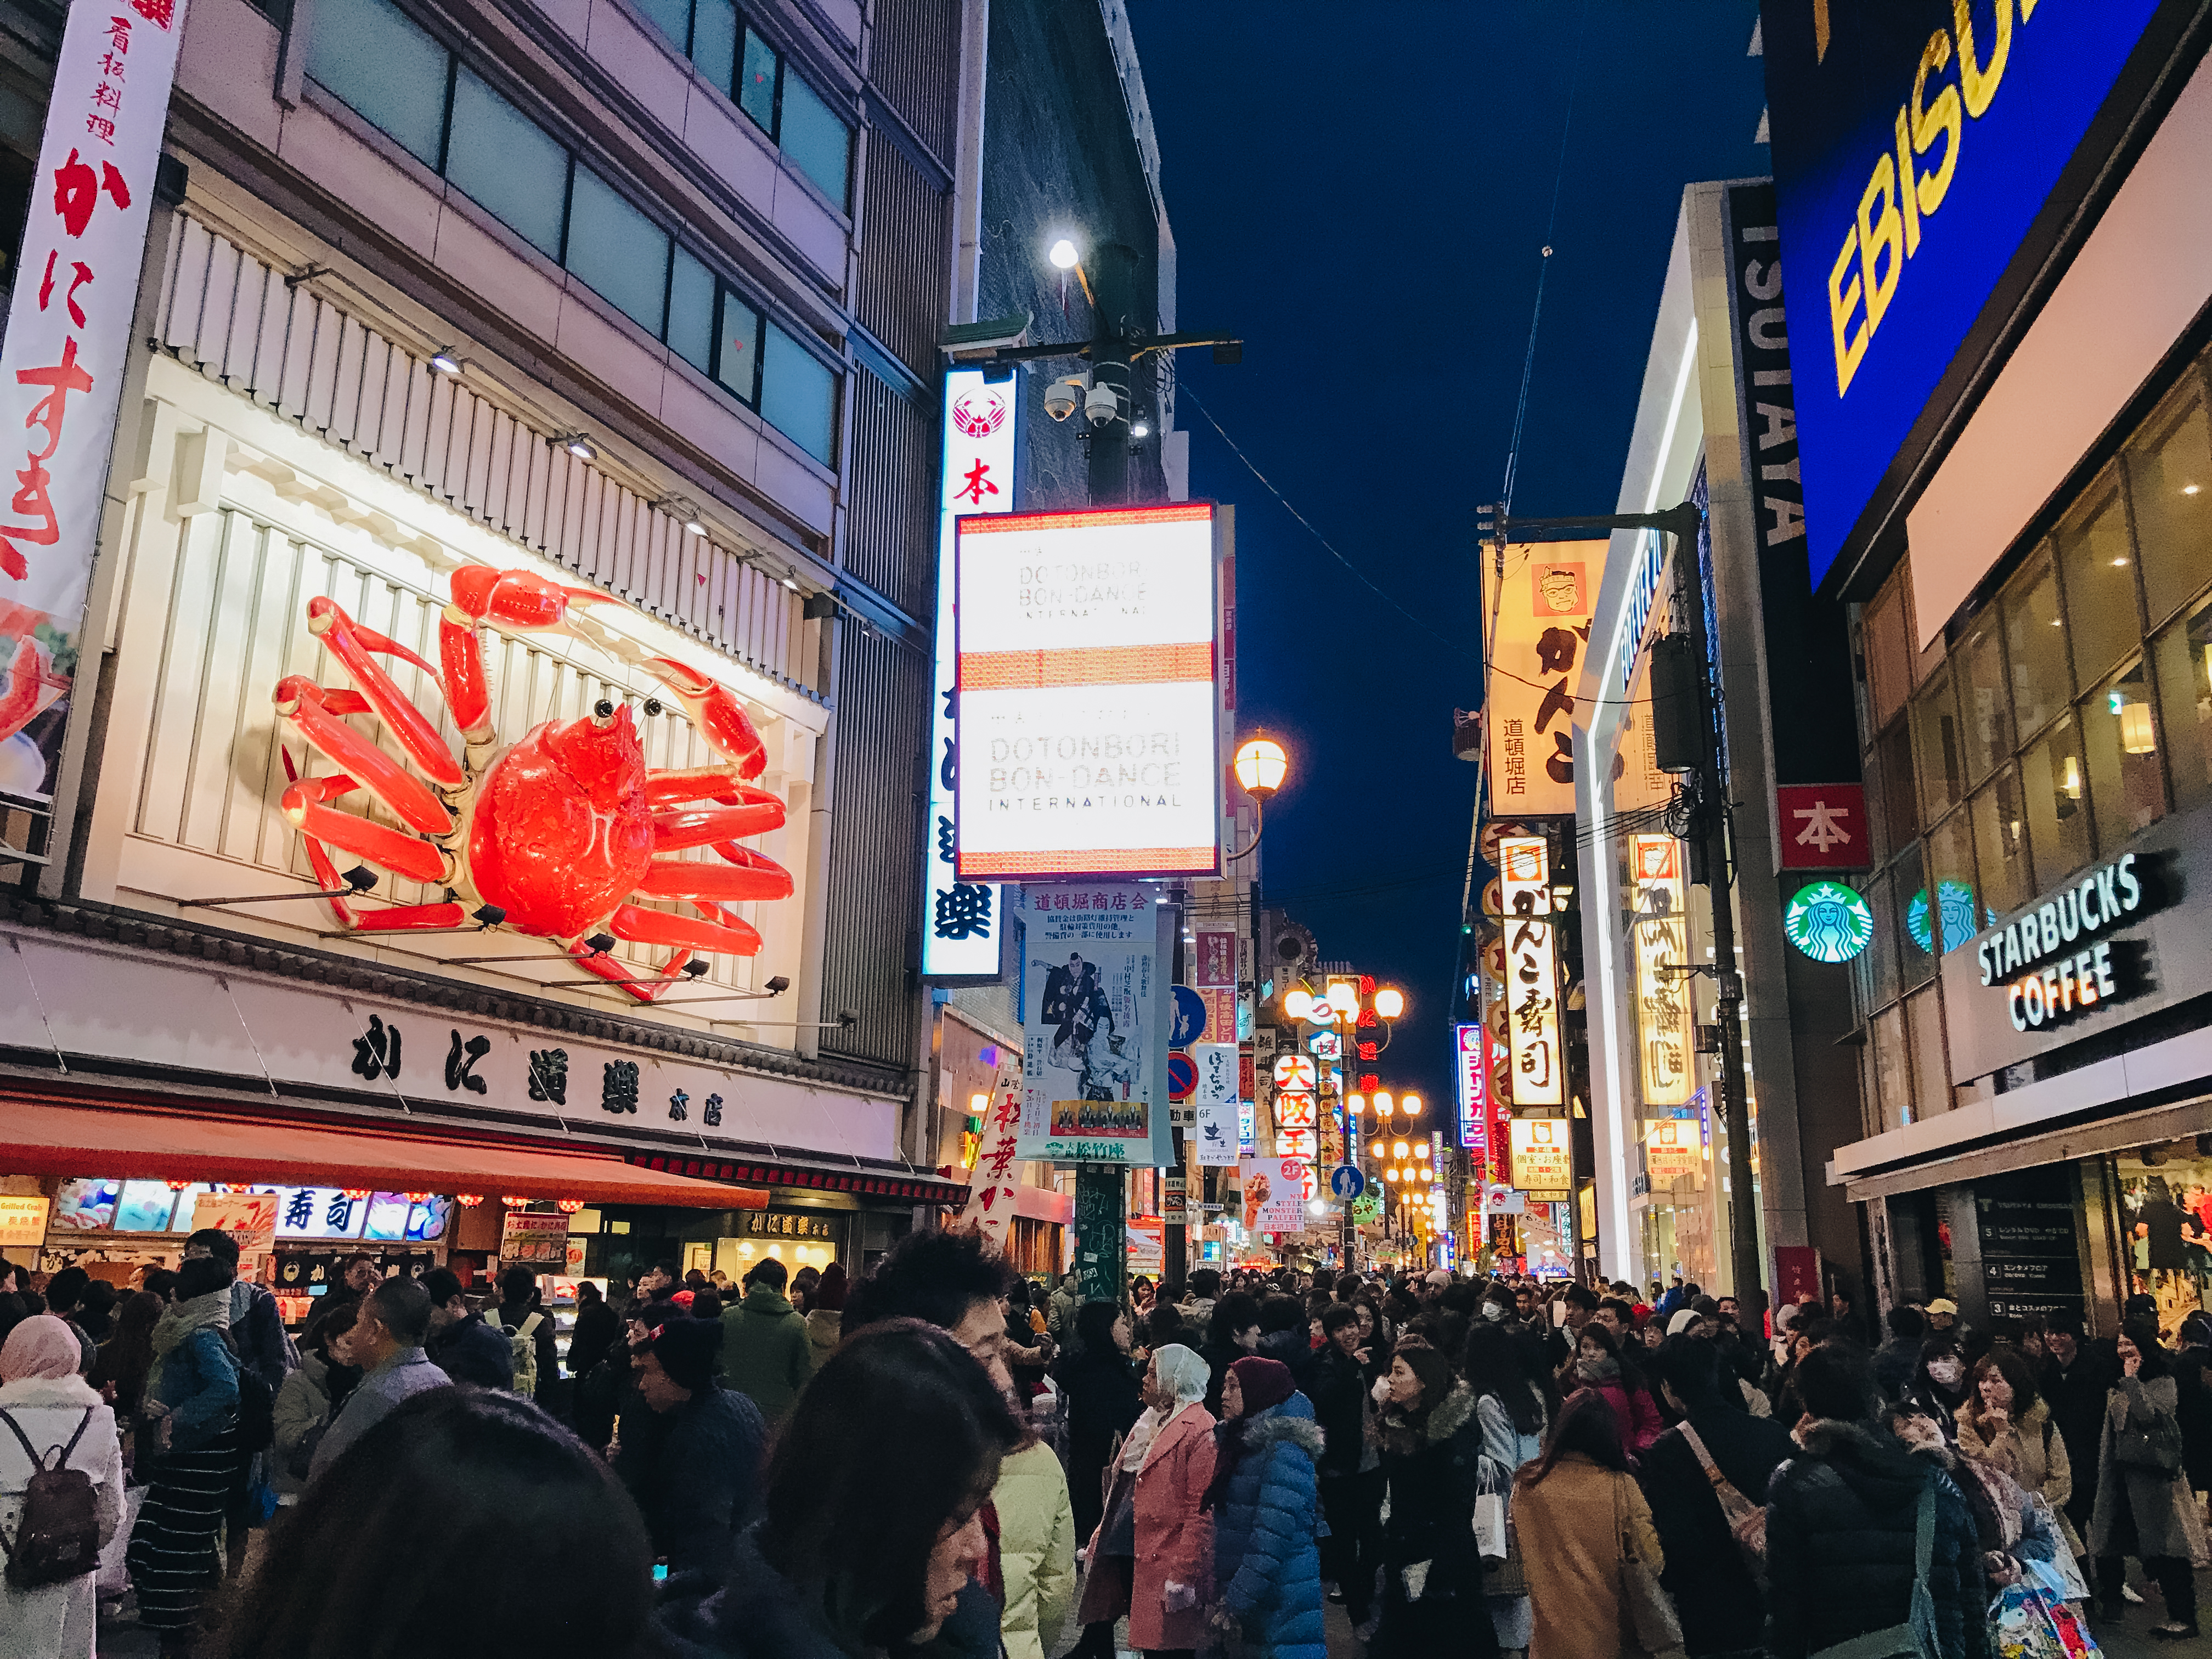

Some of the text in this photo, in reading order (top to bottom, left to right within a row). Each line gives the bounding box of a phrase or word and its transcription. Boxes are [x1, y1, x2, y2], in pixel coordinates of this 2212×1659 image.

[1829, 0, 2042, 399] EBISU
[1020, 561, 1147, 584] DOTONBOR
[991, 732, 1180, 763] DOTONBORI
[1503, 718, 1526, 795] 道頓堀店
[990, 761, 1181, 792] BON-DANCE
[990, 794, 1181, 811] INTERNATIONAL
[1793, 800, 1851, 853] 本
[1034, 891, 1149, 911] 道頓堀商店会
[1977, 853, 2141, 987] STARBUCKS
[2008, 941, 2115, 1032] COFFEE
[1199, 1109, 1211, 1118] 6F
[1284, 1165, 1299, 1175] 2F
[1, 1202, 25, 1210] Grilled
[1989, 1266, 1996, 1276] 4
[1994, 1304, 2001, 1313] 3
